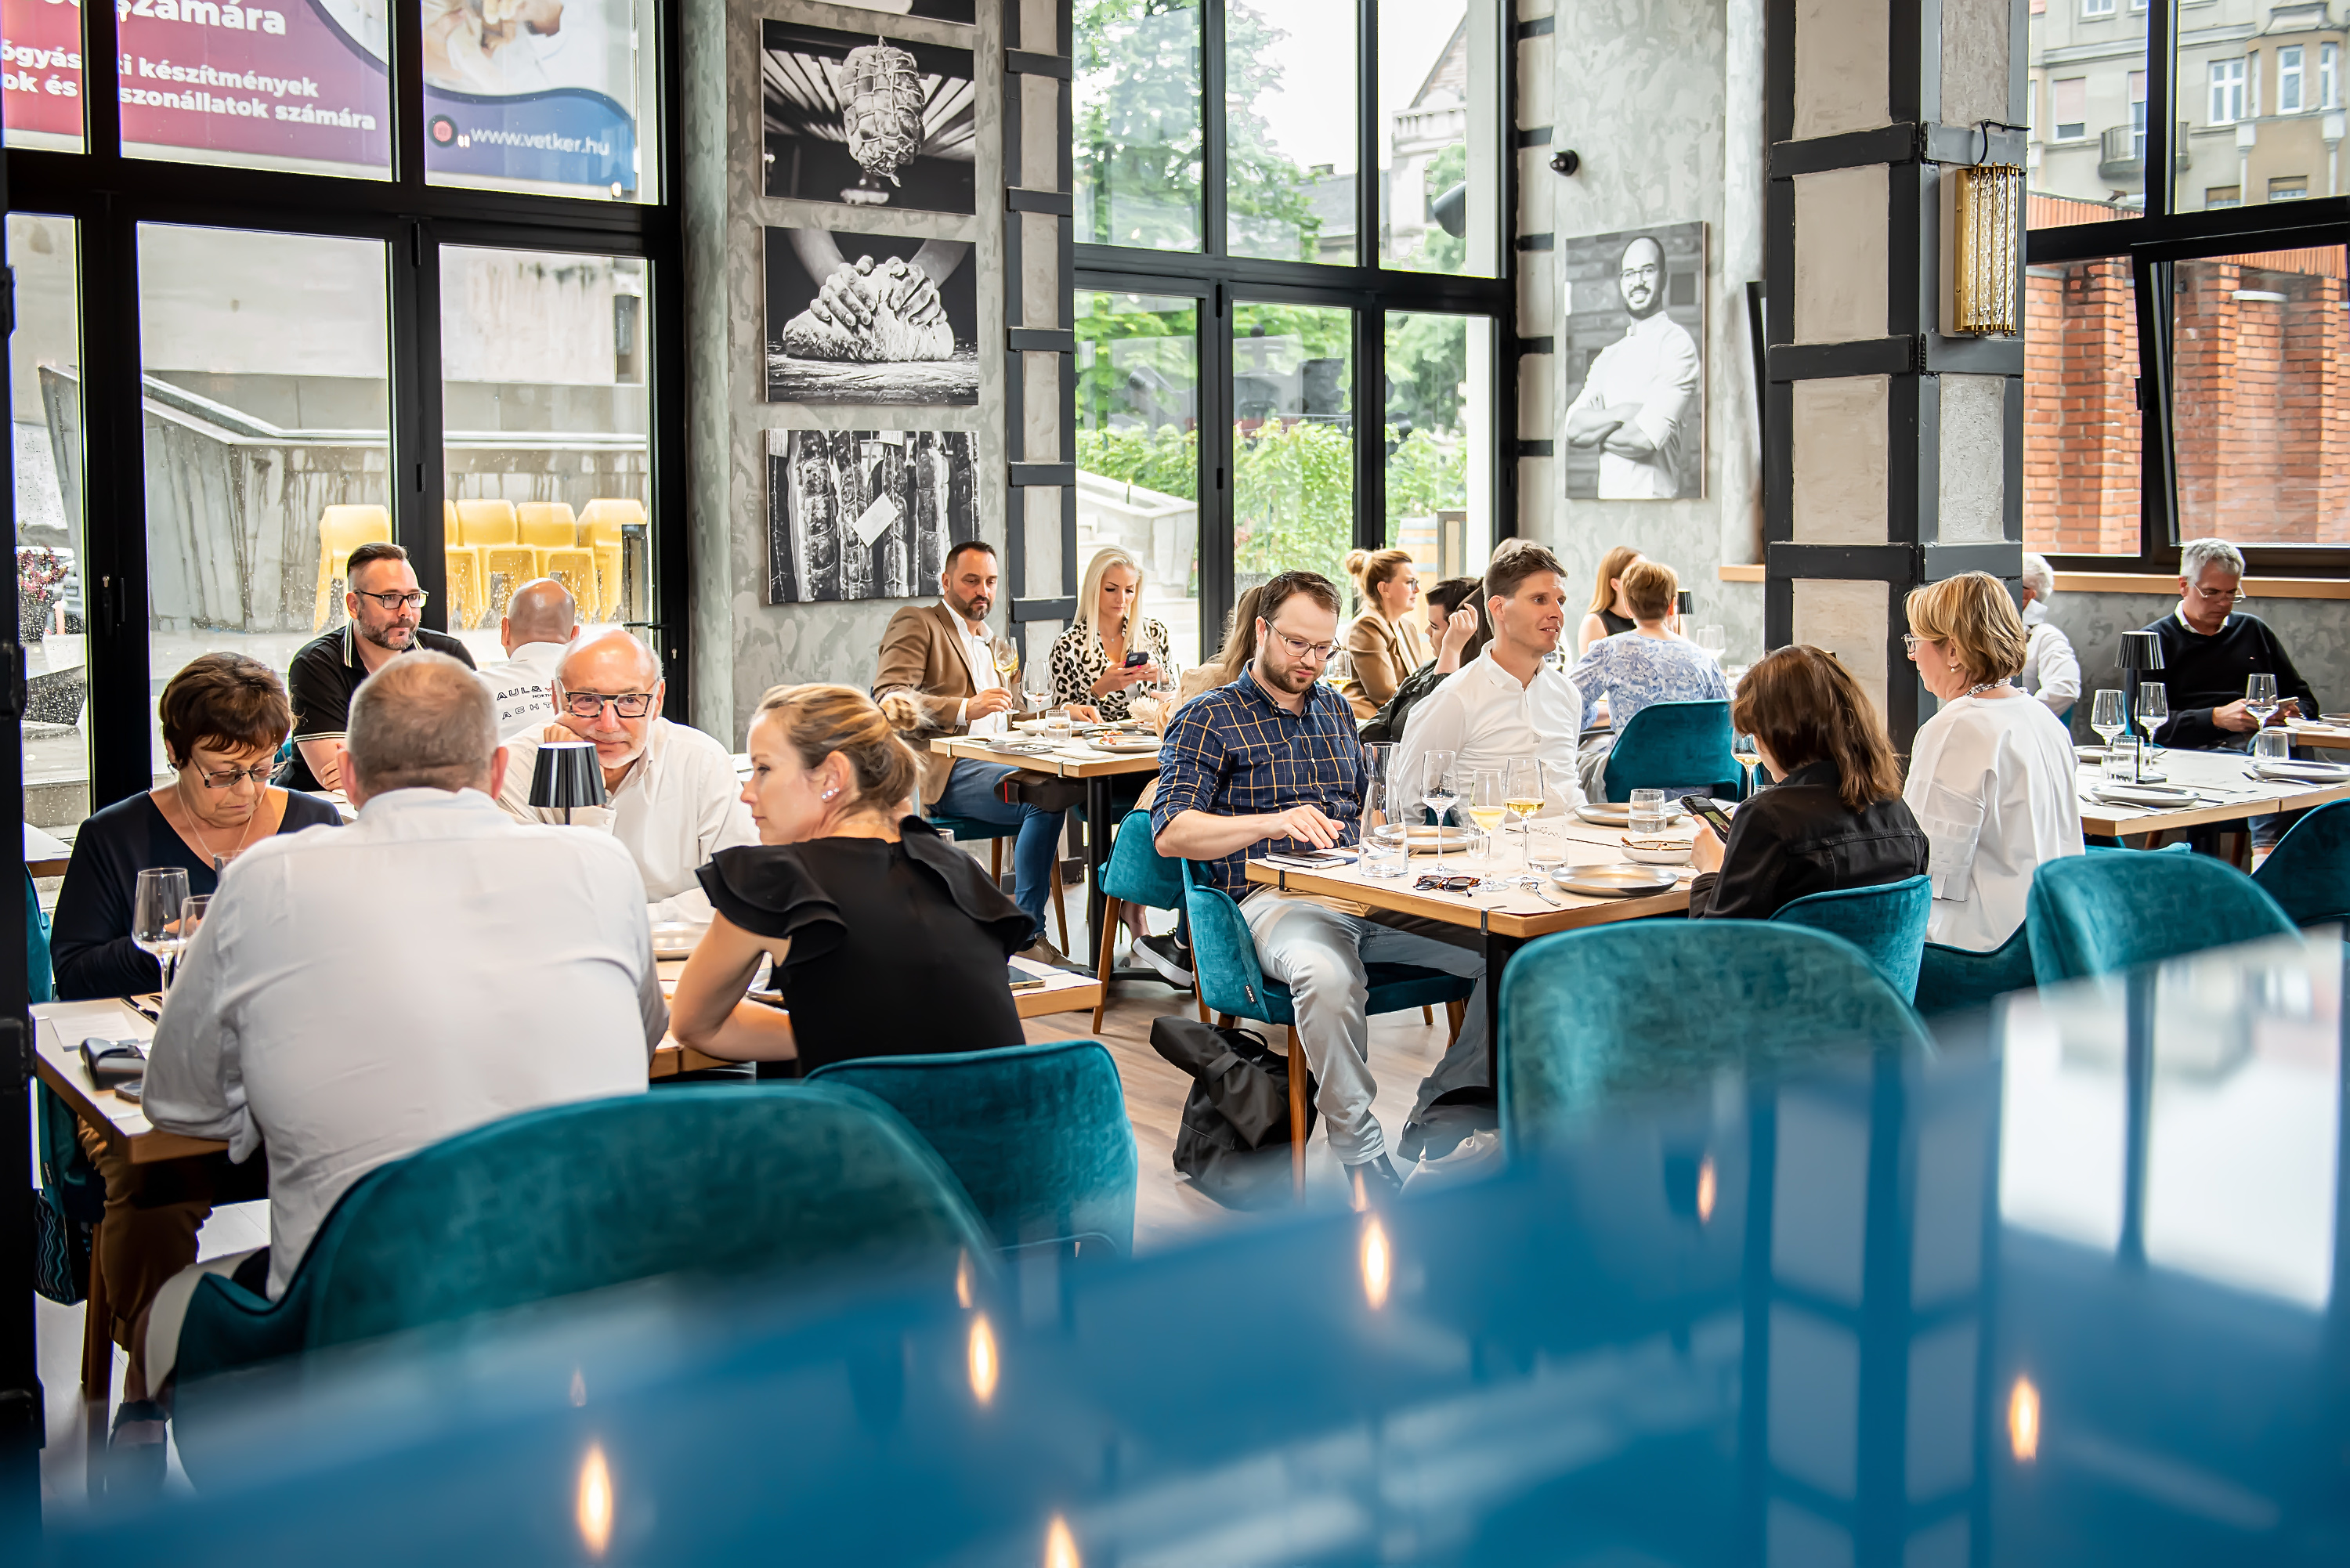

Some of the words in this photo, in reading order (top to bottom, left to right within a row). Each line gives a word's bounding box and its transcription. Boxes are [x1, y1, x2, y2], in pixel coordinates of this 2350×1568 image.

[138, 57, 319, 98] készítmények
[45, 74, 78, 96] és
[275, 104, 376, 130] számára
[471, 128, 609, 156] www.vetker.hu
